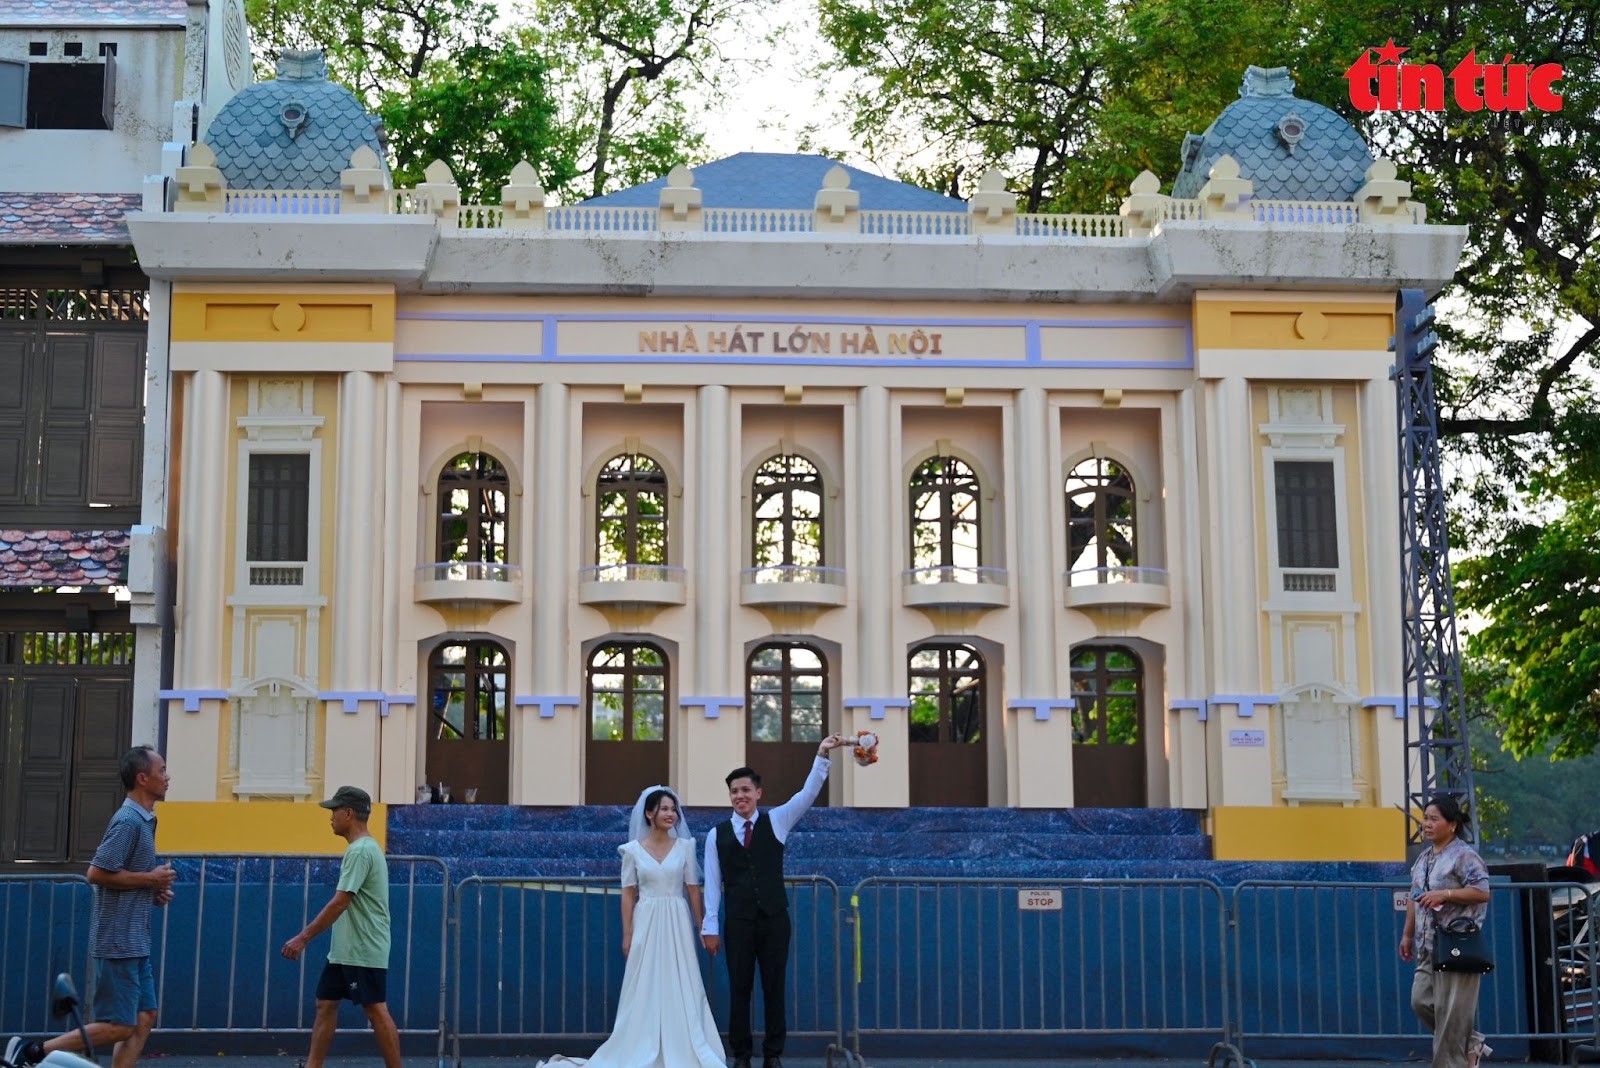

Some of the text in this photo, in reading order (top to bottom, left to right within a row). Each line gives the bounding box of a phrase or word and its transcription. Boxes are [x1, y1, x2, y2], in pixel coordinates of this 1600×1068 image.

[639, 324, 943, 359] NHÀ HÁT LỚN HÀ NỘI
[1027, 898, 1054, 906] STOP
